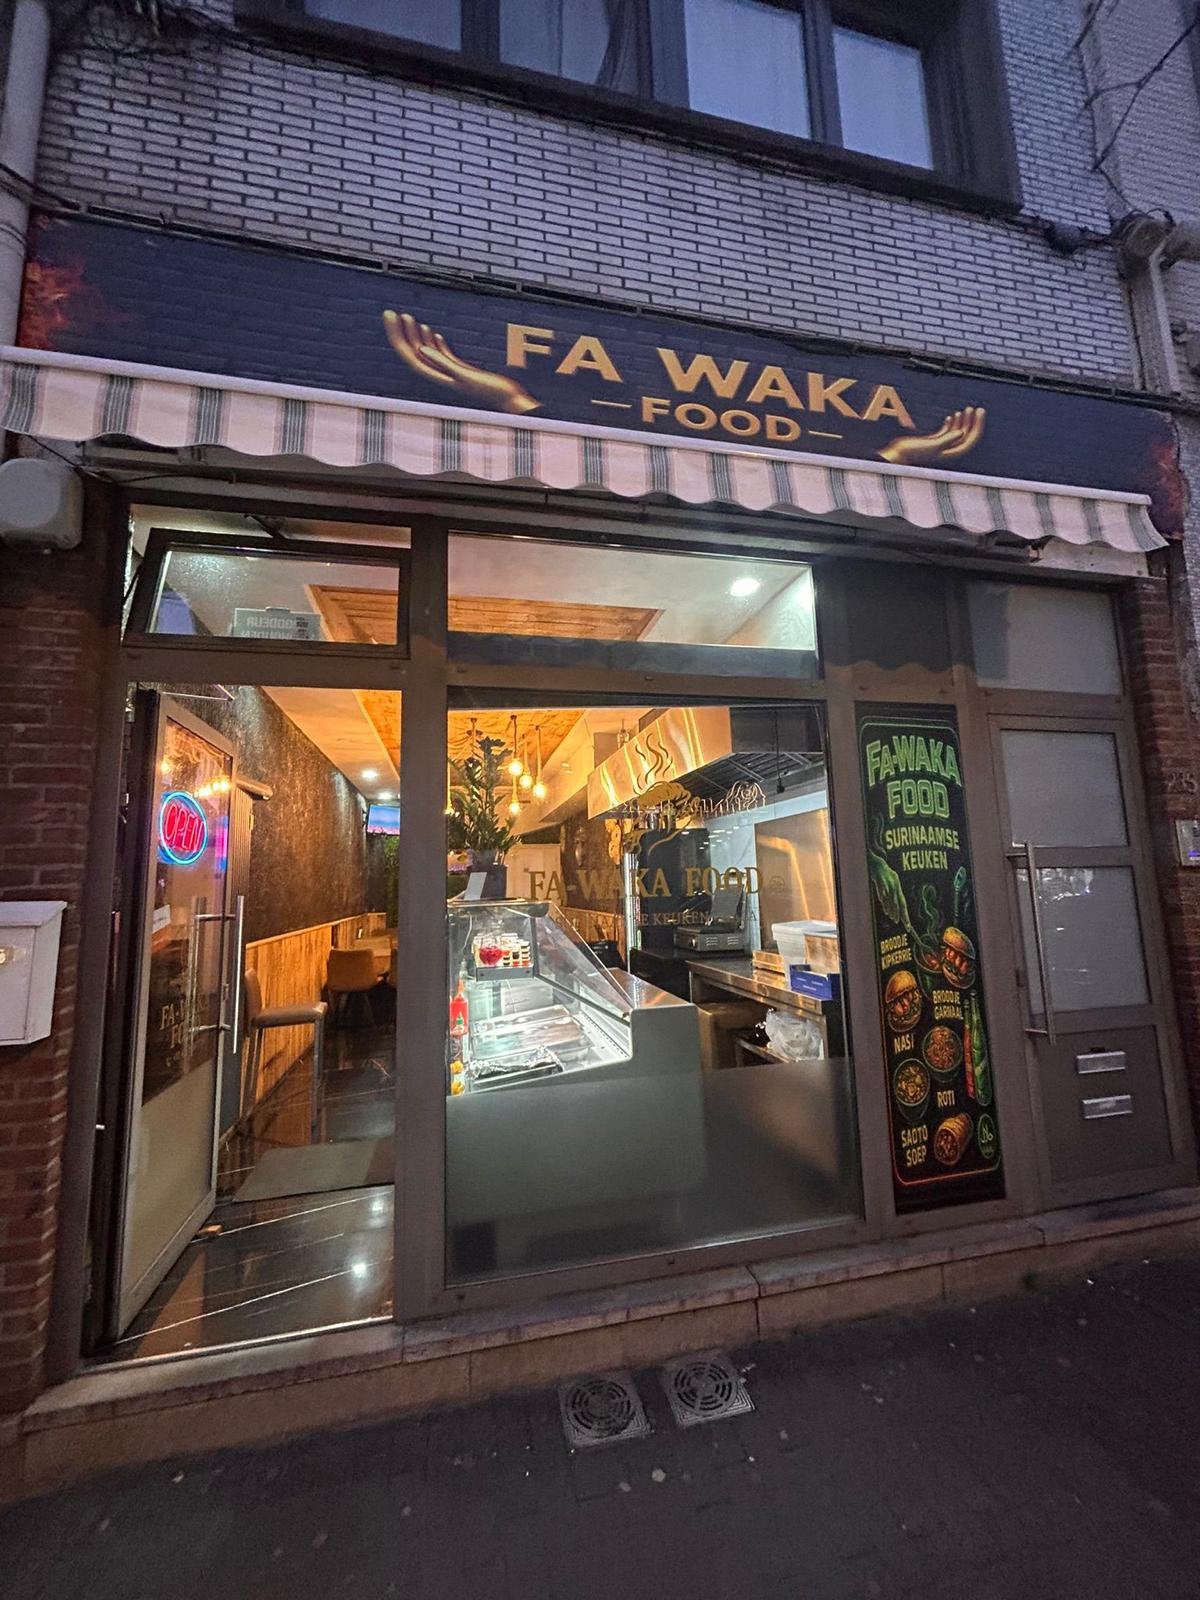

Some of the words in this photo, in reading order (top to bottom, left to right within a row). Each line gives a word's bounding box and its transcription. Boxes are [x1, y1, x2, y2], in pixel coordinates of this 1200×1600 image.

[507, 322, 623, 382] FA
[656, 347, 915, 429] WAKA
[642, 396, 801, 442] FOOD
[866, 735, 962, 787] FA-WAKA
[887, 779, 950, 819] FOOD
[164, 802, 206, 852] OPEN
[885, 825, 960, 850] SURINAAMSE
[902, 851, 949, 871] KEUKEN
[528, 866, 672, 901] FA-WAKA
[685, 866, 764, 898] FOOD
[894, 1034, 914, 1053] NASI
[937, 1090, 955, 1108] ROTI
[901, 1125, 928, 1147] SAOTO
[906, 1145, 927, 1167] SOEP
